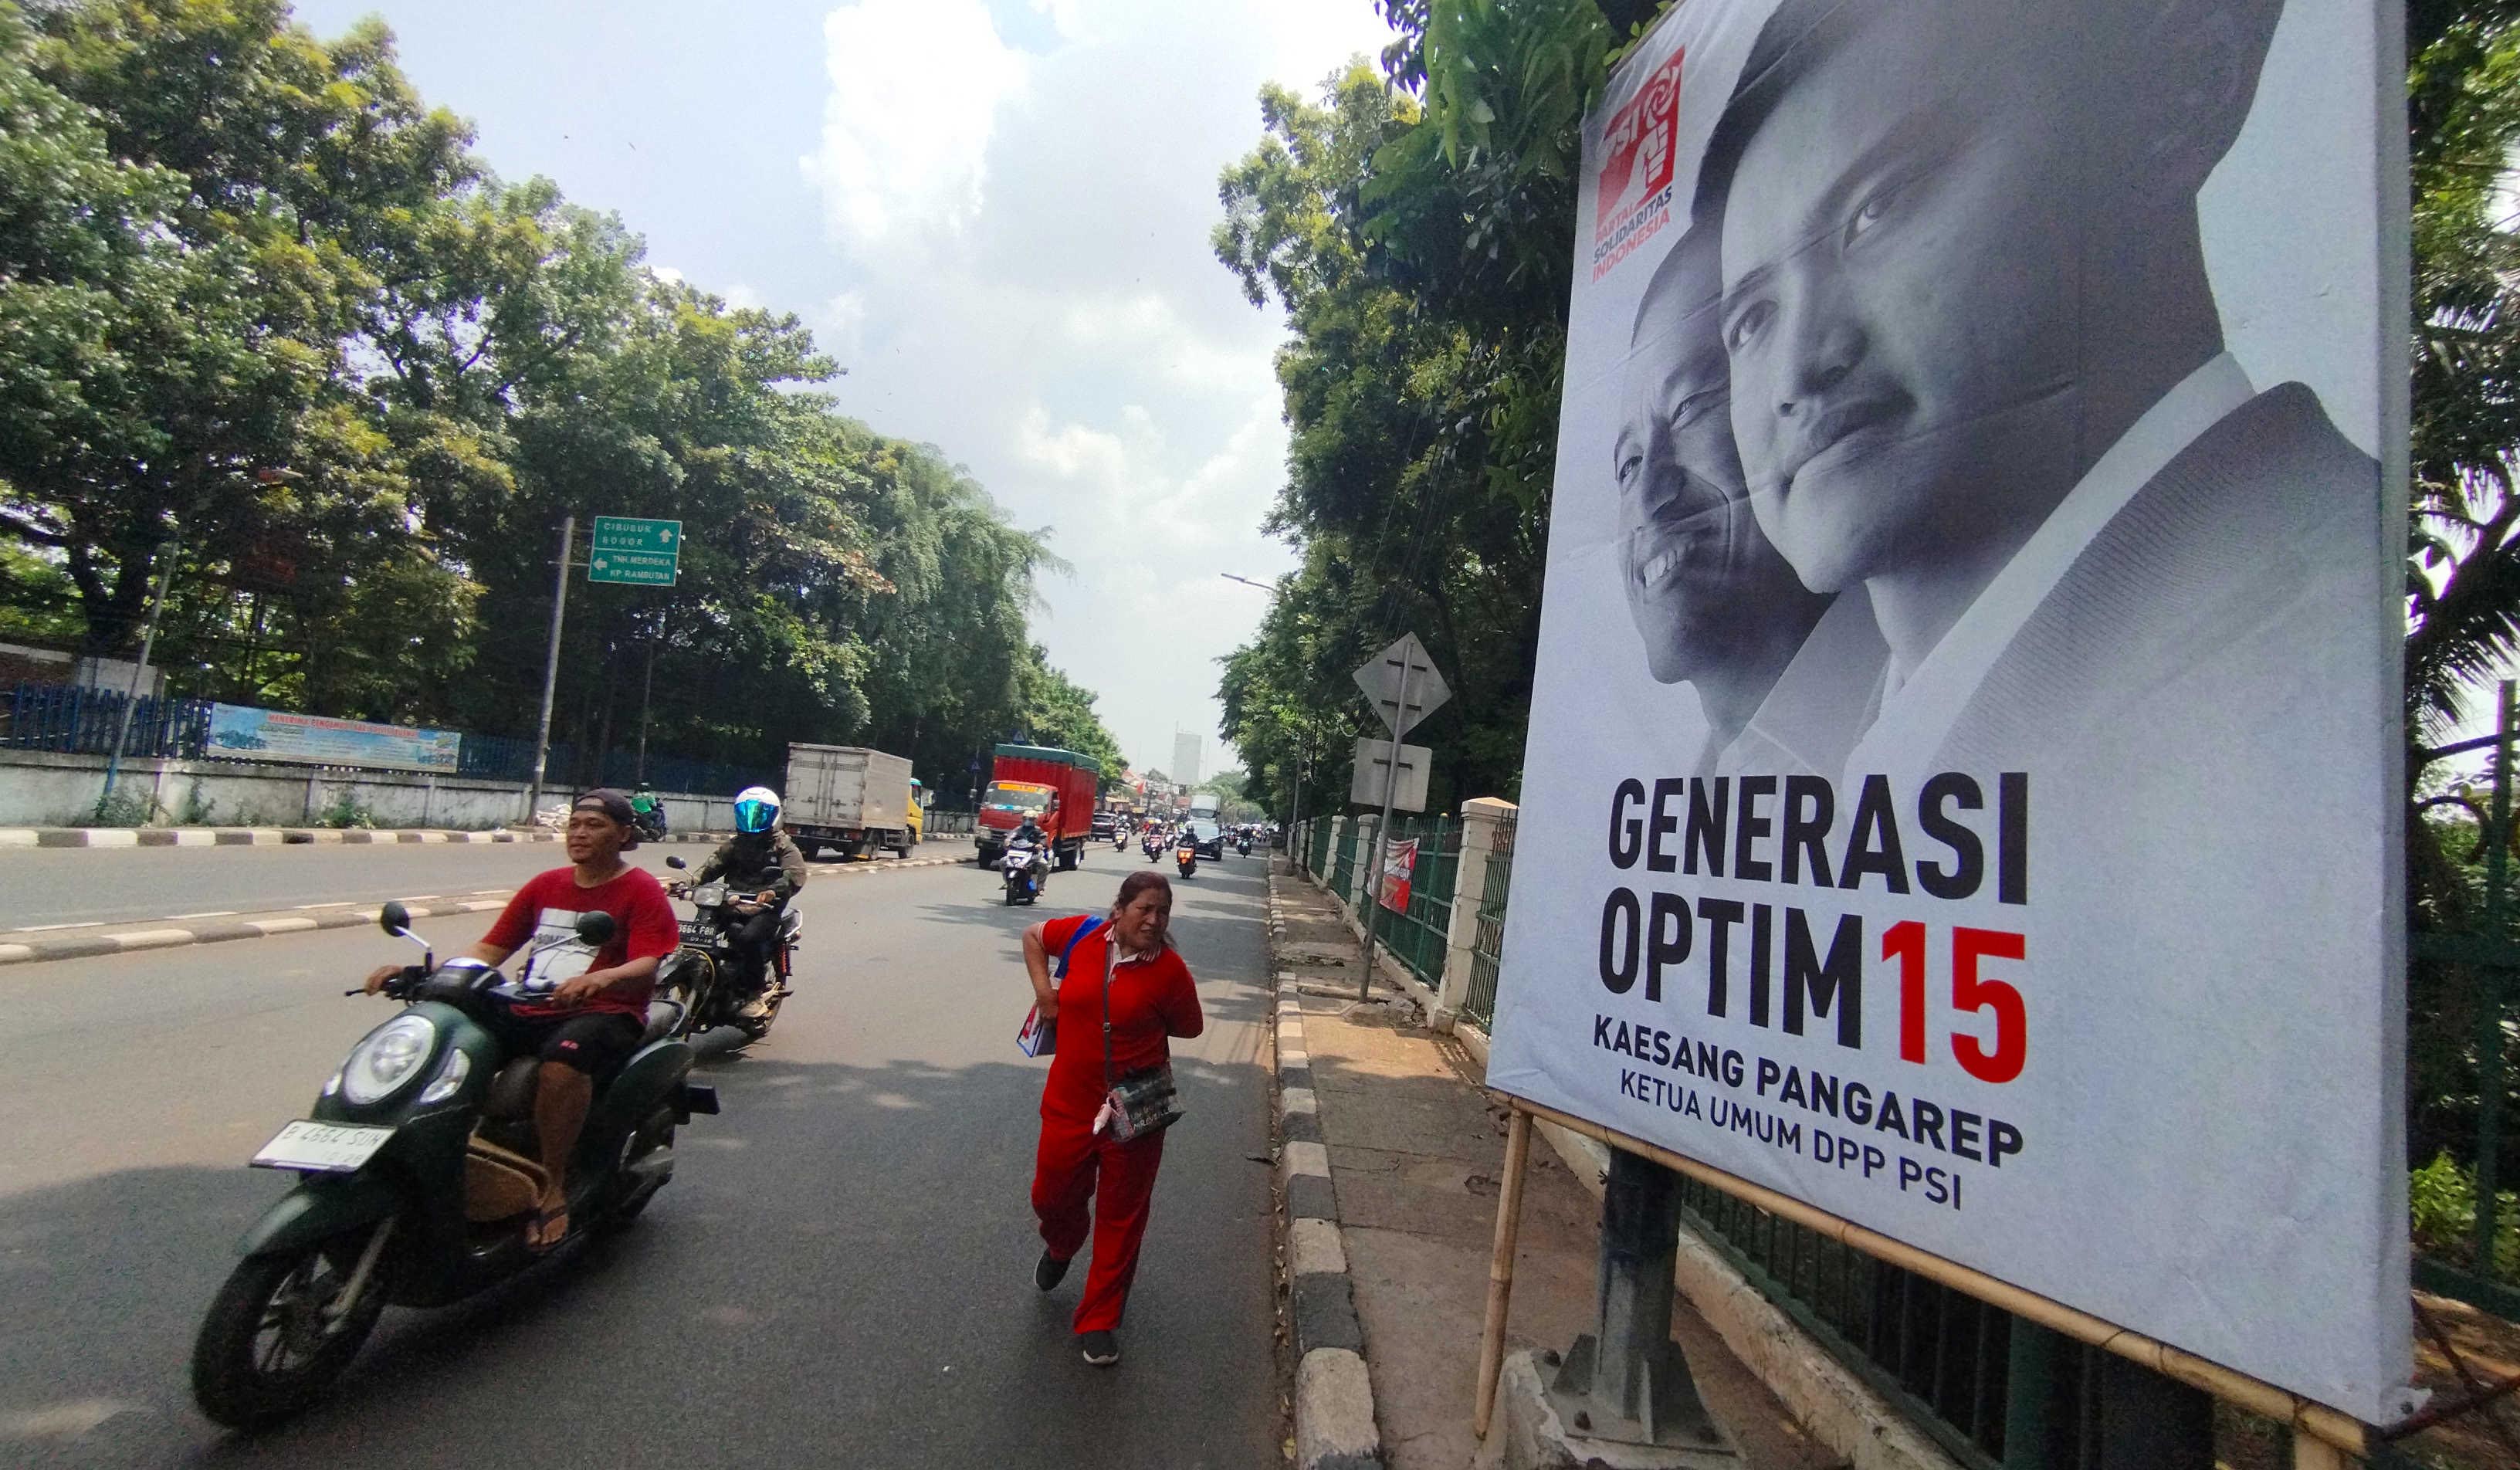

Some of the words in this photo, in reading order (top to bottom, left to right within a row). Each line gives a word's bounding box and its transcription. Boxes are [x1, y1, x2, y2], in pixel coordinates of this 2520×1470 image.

[1594, 185, 1672, 264] SOLIDARITAS
[1595, 202, 1634, 244] PARTAI
[1593, 207, 1670, 283] INDONESIA
[602, 537, 642, 547] BOGOR
[604, 523, 652, 533] CIBUBUR
[625, 571, 670, 580] RAMBUTAN
[630, 557, 671, 566] MERDEKA
[1608, 772, 2028, 906] GENERASI
[1594, 1014, 1745, 1088] KAESANG
[1757, 1057, 2024, 1168] PANGAREP
[281, 1126, 300, 1139] B
[300, 1127, 347, 1144] 4664
[1621, 1069, 1702, 1120] KETUA
[1710, 1098, 1802, 1154] UMUM
[1814, 1129, 1886, 1179] DPP
[1899, 1157, 1961, 1211] PSI
